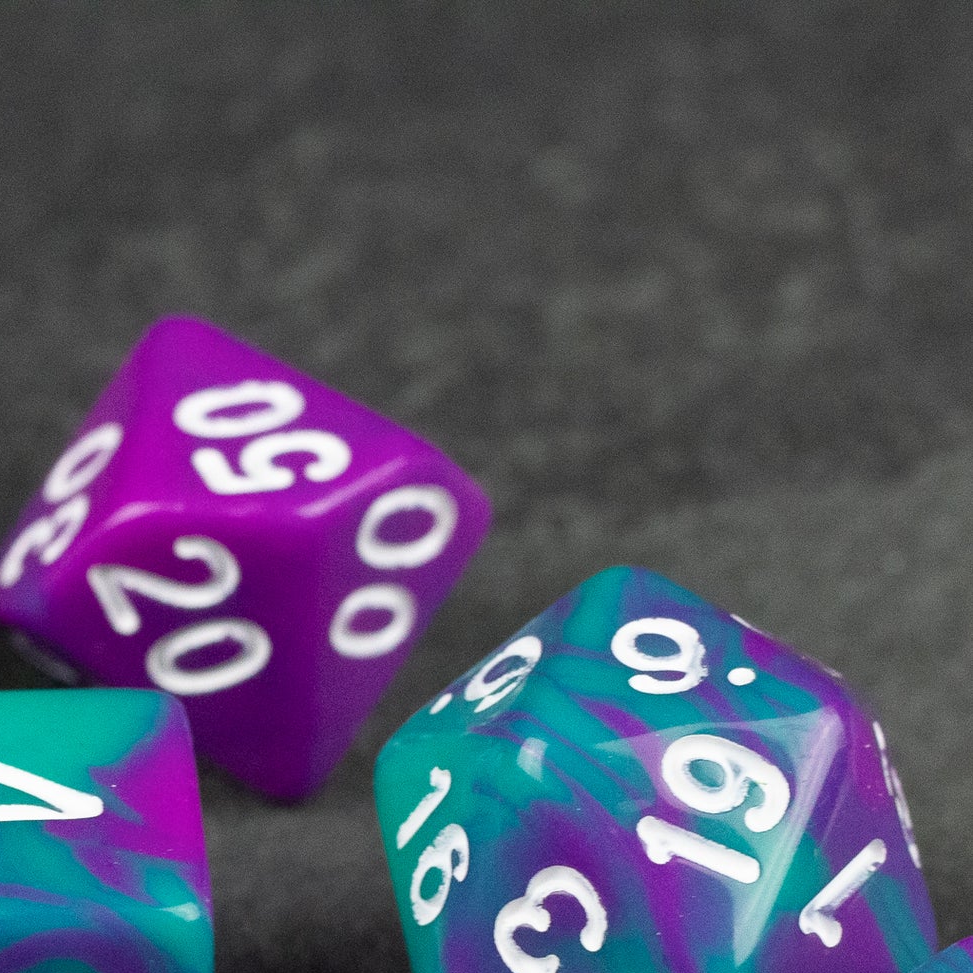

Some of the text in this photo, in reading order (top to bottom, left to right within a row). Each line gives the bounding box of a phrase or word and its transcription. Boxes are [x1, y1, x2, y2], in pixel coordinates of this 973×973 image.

[172, 380, 352, 496] 50
[86, 533, 274, 697] 20
[328, 484, 459, 659] 00
[635, 732, 791, 884] 19
